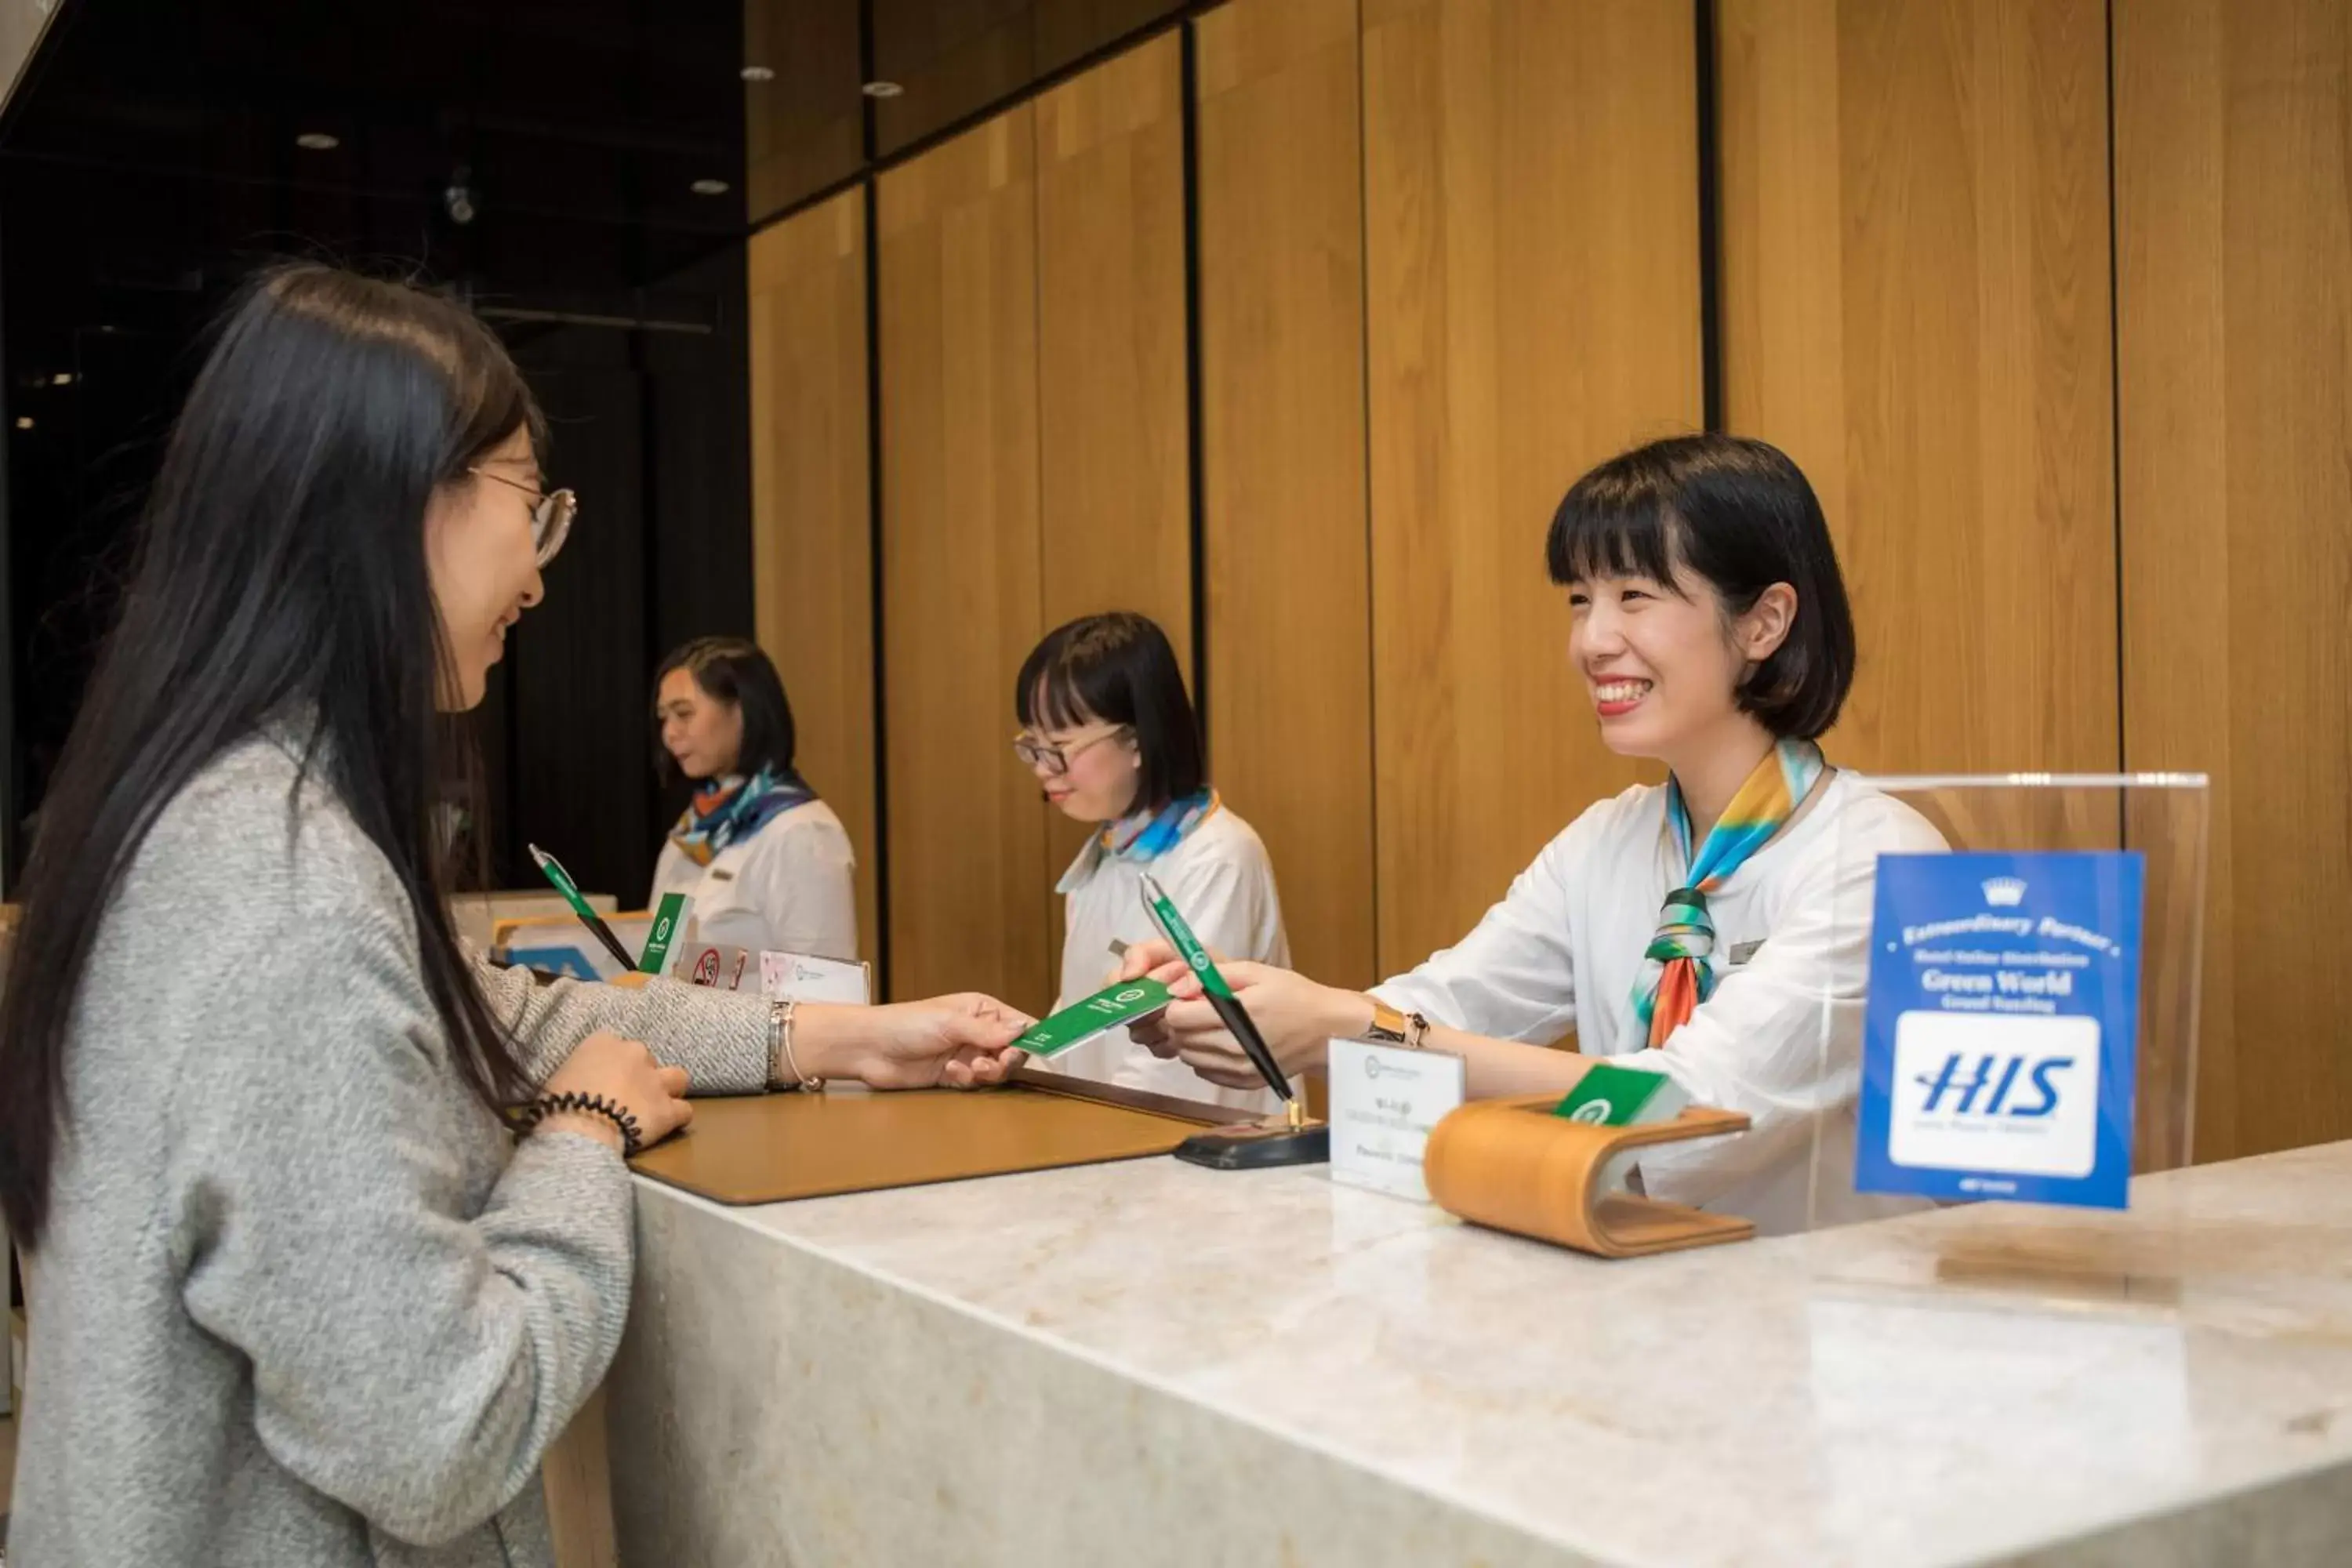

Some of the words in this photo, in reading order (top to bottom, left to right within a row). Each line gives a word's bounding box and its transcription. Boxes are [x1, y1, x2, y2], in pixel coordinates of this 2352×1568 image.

[1903, 913, 2033, 946] Extraordinary
[2038, 916, 2111, 950] Partner
[1922, 968, 1993, 993] Green
[1996, 970, 2072, 996] World
[1915, 1051, 2076, 1118] HIS
